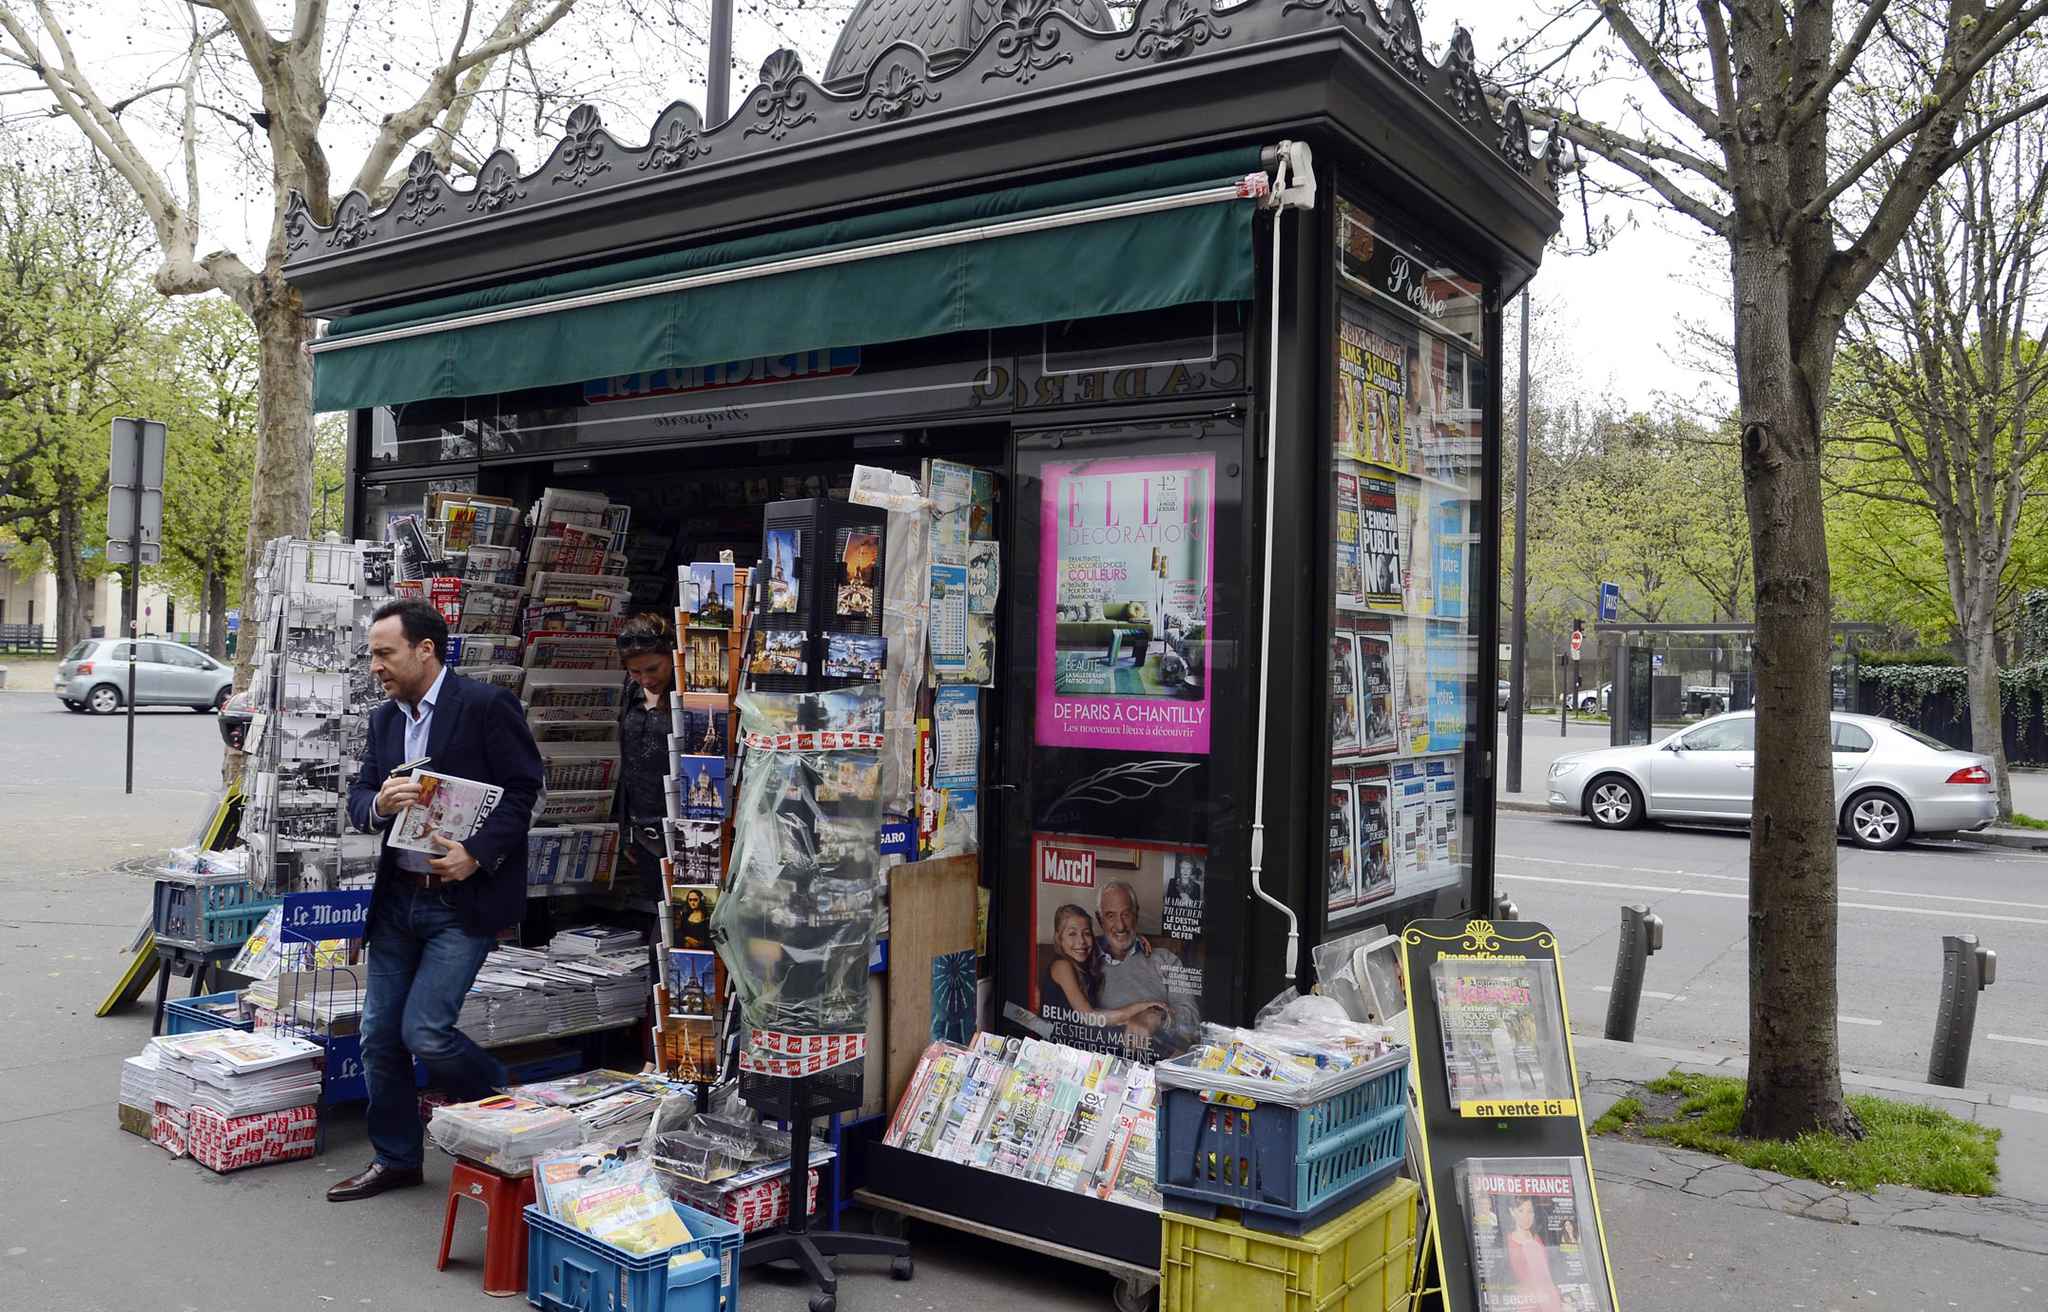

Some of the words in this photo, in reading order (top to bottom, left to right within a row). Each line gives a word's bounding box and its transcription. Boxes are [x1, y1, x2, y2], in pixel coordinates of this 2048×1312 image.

[1388, 255, 1447, 318] Presse
[1365, 351, 1374, 384] 3
[1373, 356, 1399, 383] FILMS
[1363, 527, 1400, 556] PUBLIC
[1068, 567, 1128, 582] COULEURS
[1605, 593, 1618, 610] TAXIS
[1054, 703, 1072, 720] DE
[1074, 703, 1110, 722] PARIS
[1126, 705, 1206, 724] CHANTILLY
[1063, 723, 1079, 734] Les
[1080, 725, 1120, 735] nouveaux
[1121, 724, 1144, 736] lieux
[1153, 725, 1196, 738] découvrir
[474, 787, 499, 834] IDEA
[1043, 849, 1094, 886] MATCH
[290, 904, 309, 927] Le
[308, 902, 369, 926] Monde
[1166, 915, 1174, 923] LE
[1175, 916, 1199, 926] DESTIN
[1163, 923, 1173, 931] DE
[1173, 924, 1182, 932] LA
[1182, 925, 1201, 935] DAME
[1171, 931, 1181, 939] DE
[1181, 932, 1193, 941] FER
[1042, 1003, 1107, 1028] BELMONDO
[1107, 1030, 1125, 1048] MA
[1126, 1032, 1154, 1051] FILLE
[337, 1055, 360, 1080] Le
[1475, 1103, 1495, 1117] en
[1498, 1101, 1540, 1117] vente
[1543, 1100, 1563, 1115] ici
[1474, 1174, 1505, 1192] JOUR
[1507, 1177, 1522, 1193] DE
[1524, 1177, 1571, 1195] FRANCE
